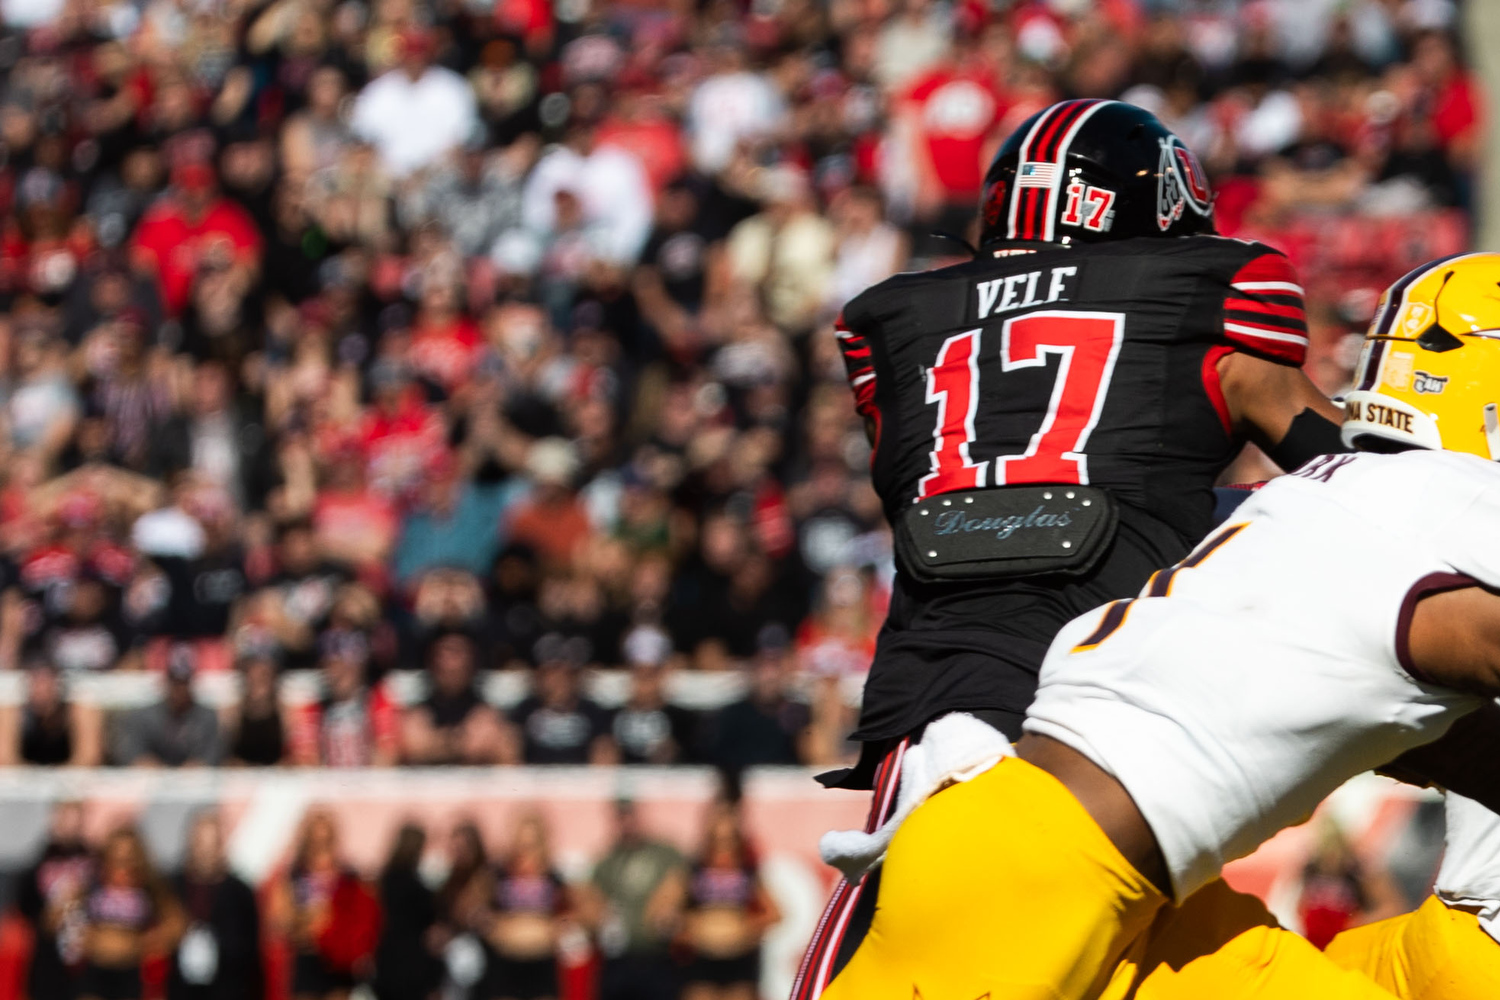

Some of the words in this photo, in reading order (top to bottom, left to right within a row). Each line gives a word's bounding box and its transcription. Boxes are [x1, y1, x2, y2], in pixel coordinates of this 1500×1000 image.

[1061, 183, 1116, 232] 17
[913, 310, 1127, 504] 17
[1366, 403, 1414, 434] STATE
[934, 505, 1072, 540] Douglas
